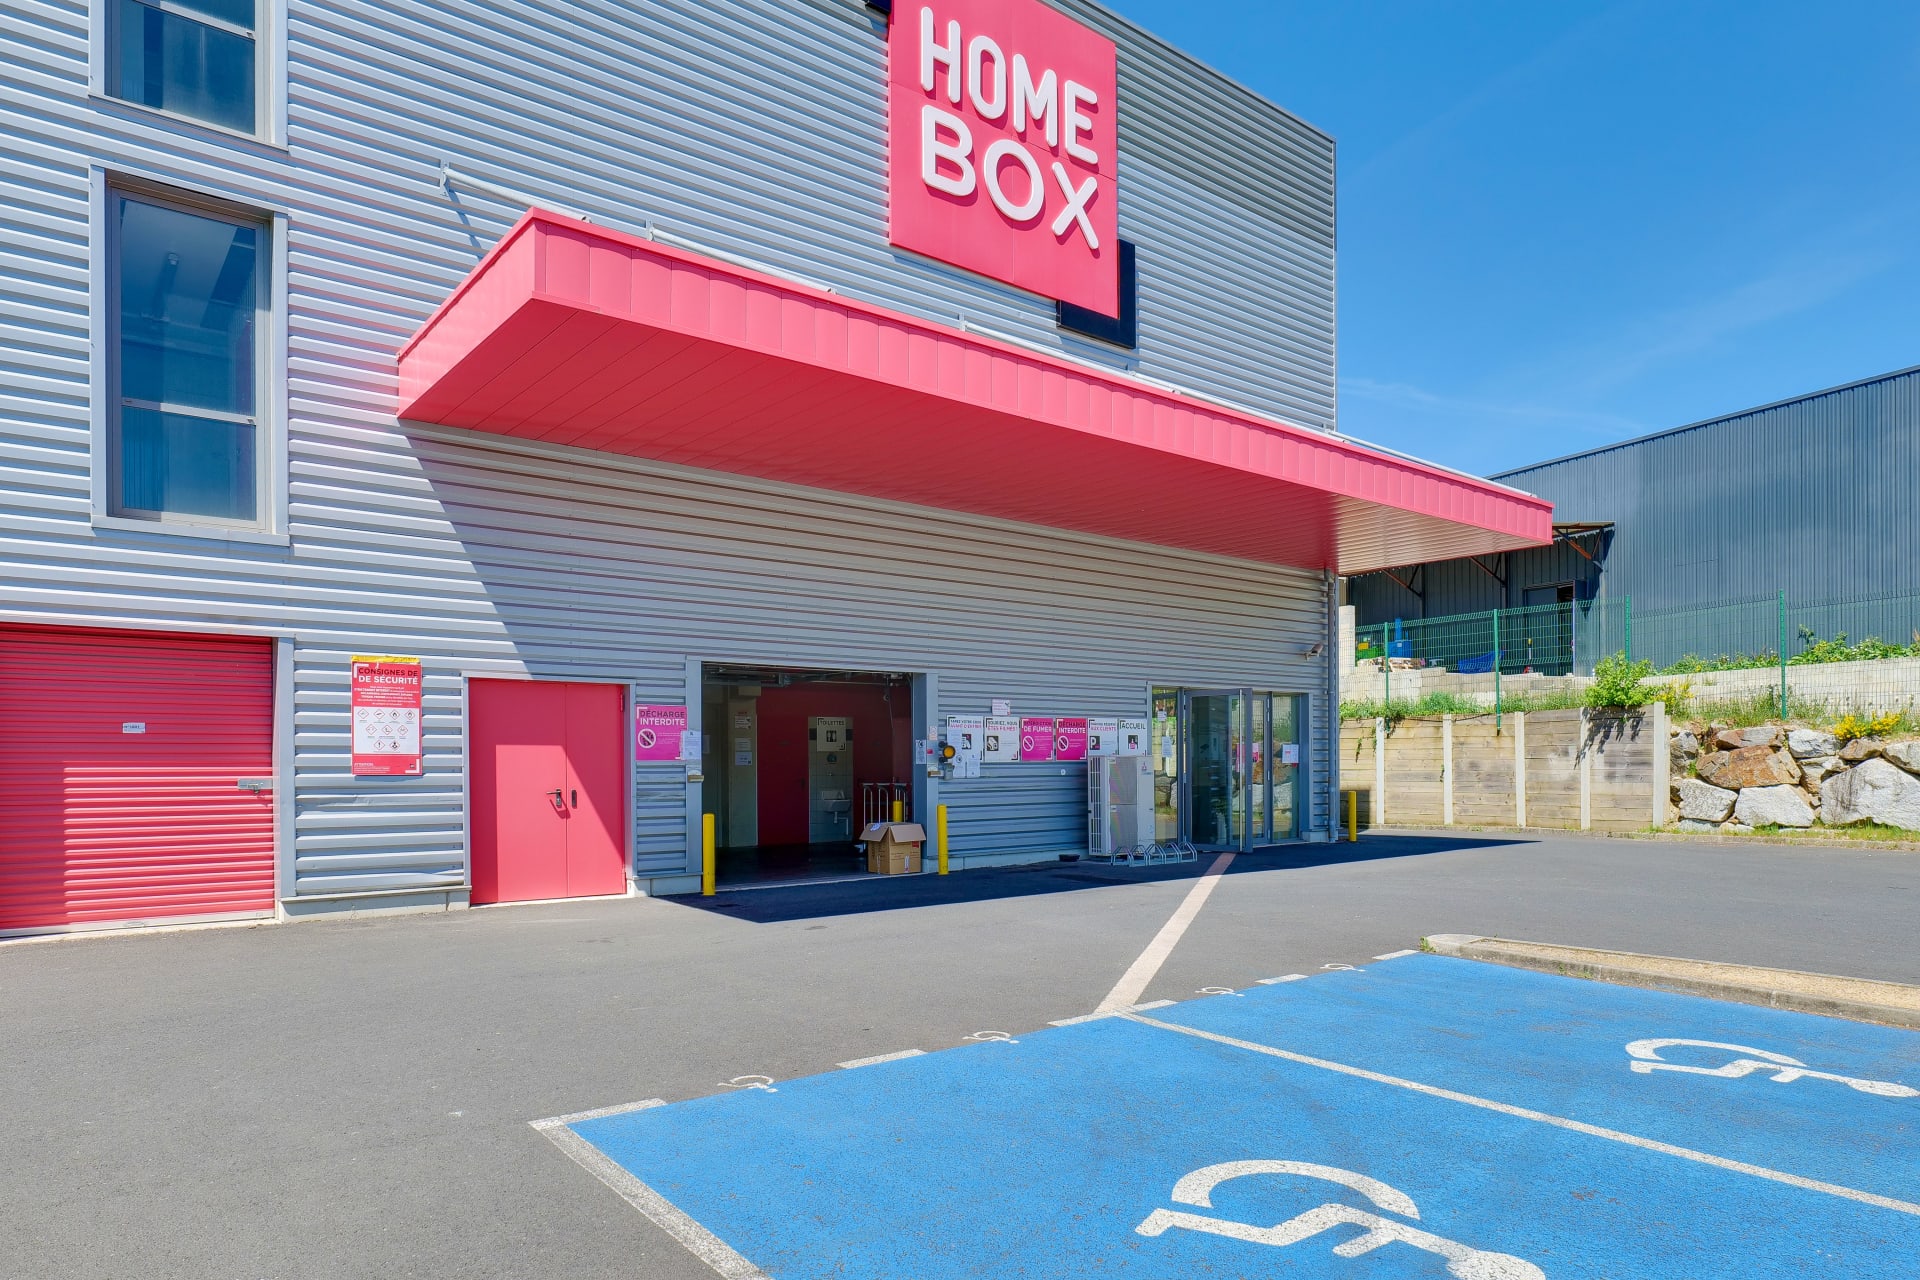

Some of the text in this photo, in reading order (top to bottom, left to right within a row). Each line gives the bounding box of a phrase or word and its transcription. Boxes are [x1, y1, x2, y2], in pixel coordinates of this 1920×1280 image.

[920, 6, 1098, 165] HOME
[921, 104, 1100, 250] BOX
[358, 667, 419, 677] CONSIGNES DE
[374, 675, 418, 685] SÉCURITÉ
[640, 710, 685, 718] DÉCHARGE
[640, 718, 685, 726] INTERDITE
[1121, 722, 1146, 730] ACCUEIL
